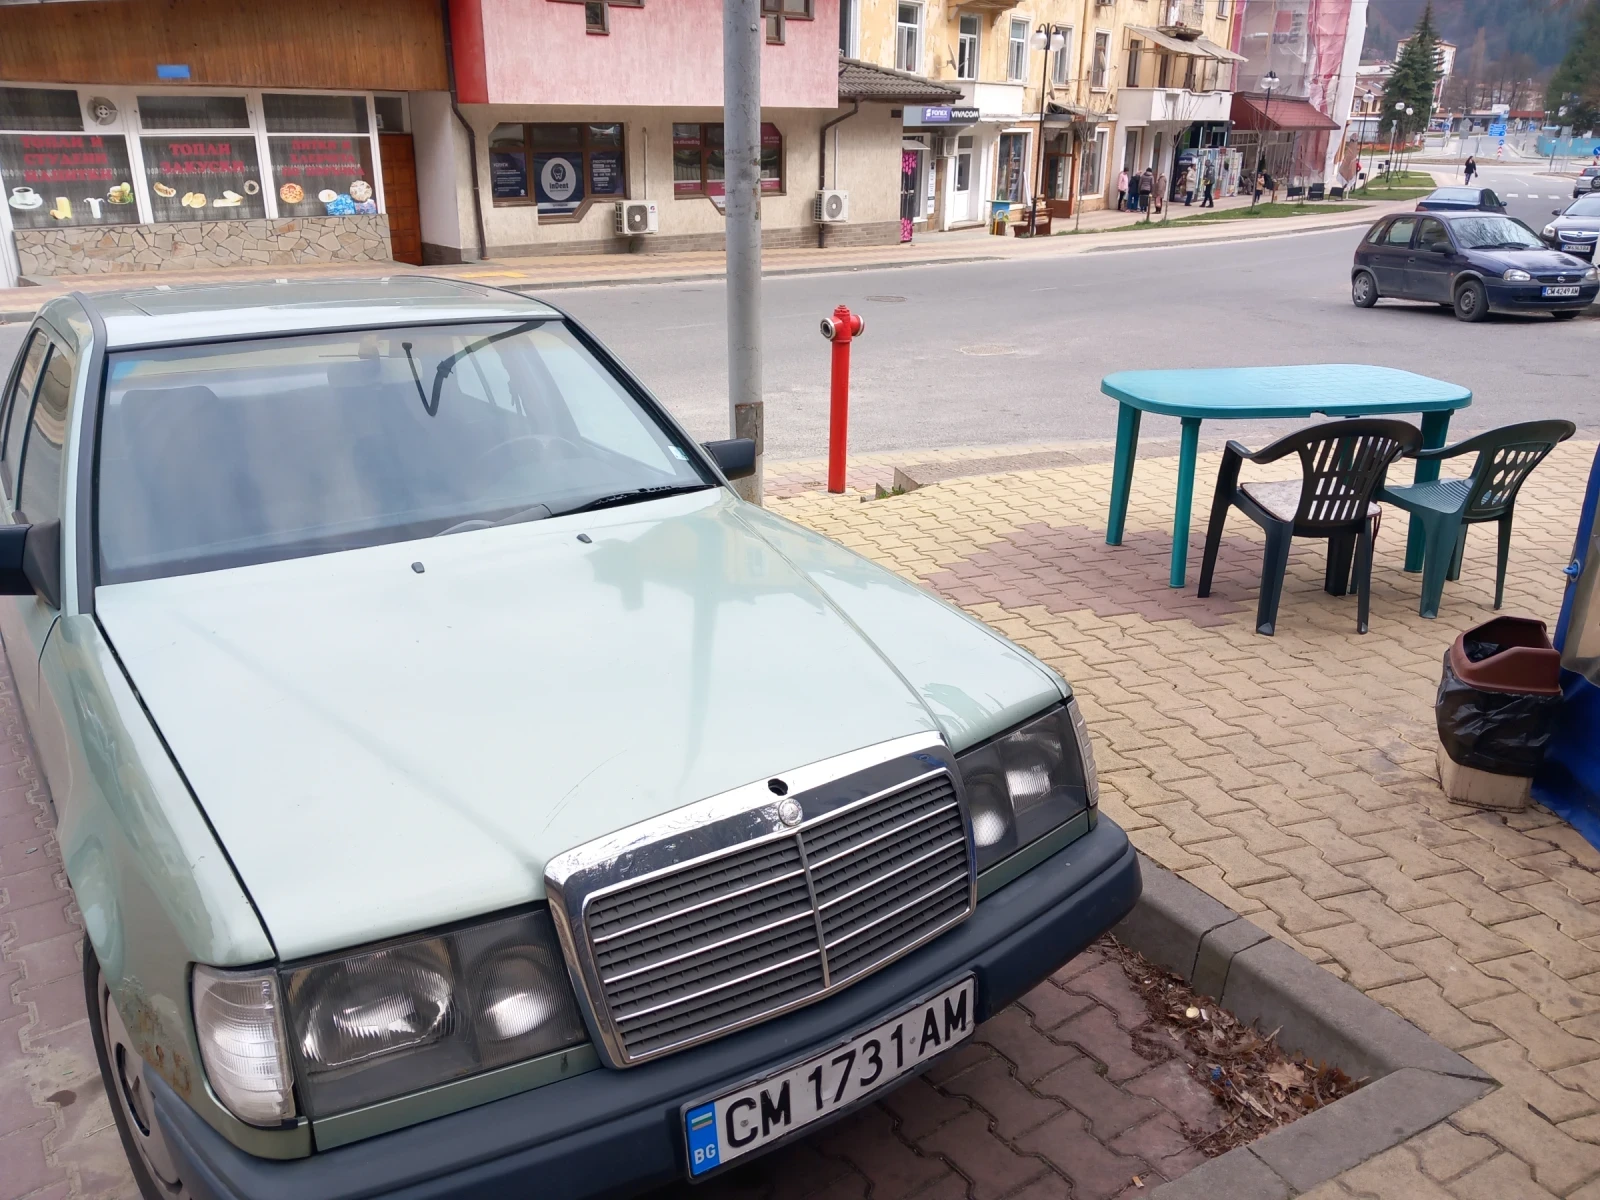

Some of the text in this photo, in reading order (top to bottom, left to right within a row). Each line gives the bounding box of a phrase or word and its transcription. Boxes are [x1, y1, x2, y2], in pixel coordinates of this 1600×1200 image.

[951, 110, 979, 118] VIVACOM
[169, 143, 231, 156] ТОПЛИ
[160, 161, 245, 173] ЗАКУСКИ
[725, 989, 968, 1148] CM 1731 AM
[693, 1143, 716, 1165] BG
